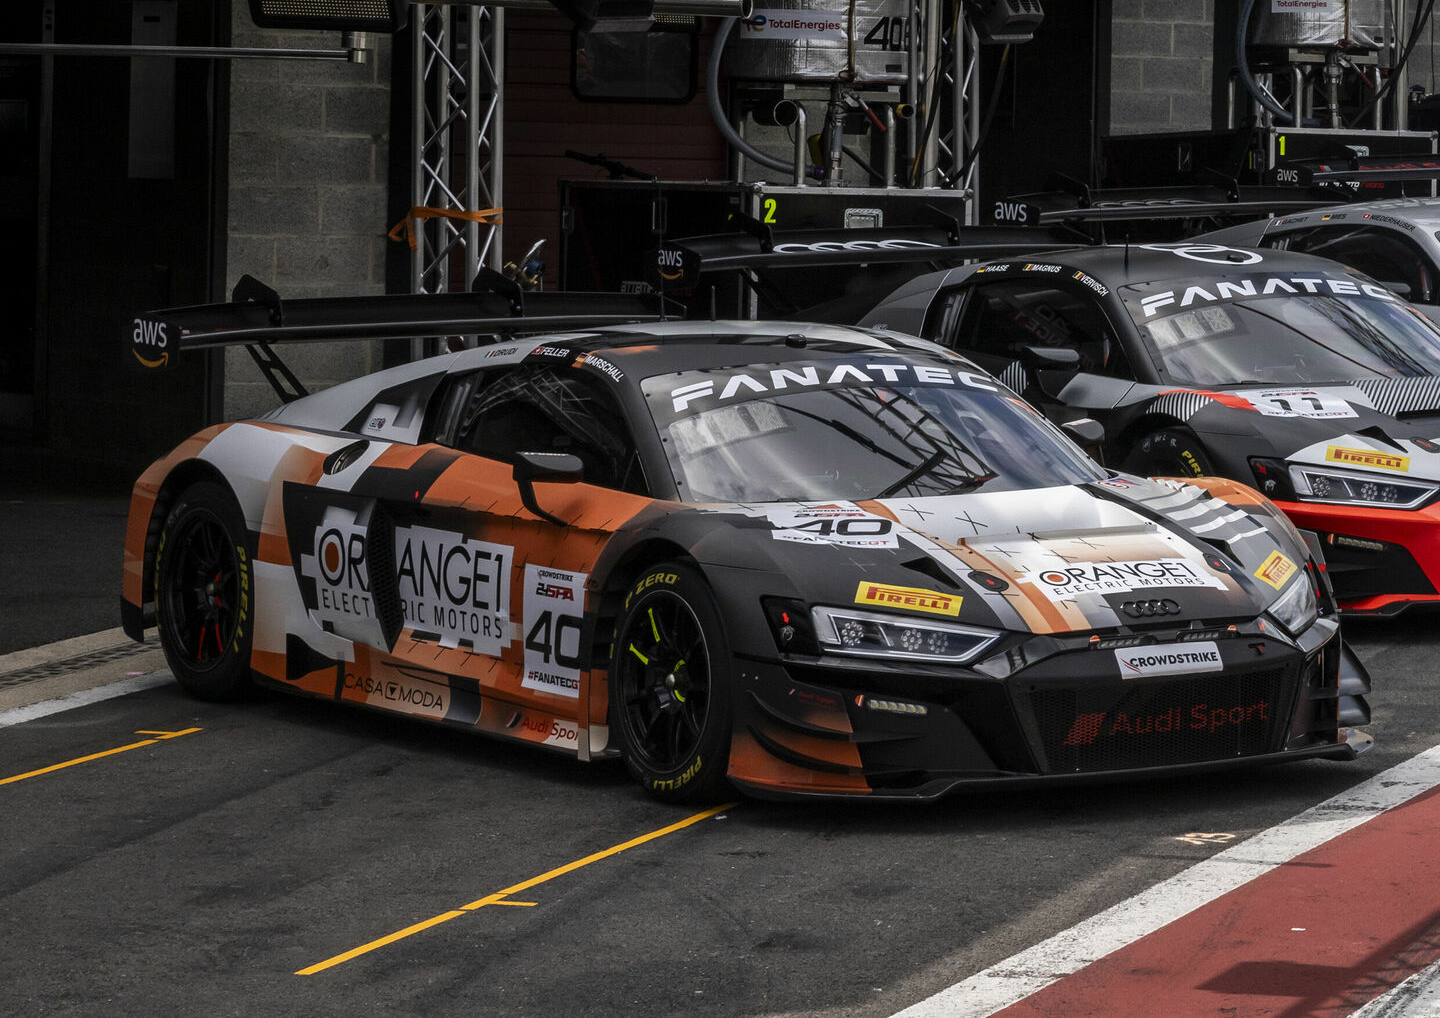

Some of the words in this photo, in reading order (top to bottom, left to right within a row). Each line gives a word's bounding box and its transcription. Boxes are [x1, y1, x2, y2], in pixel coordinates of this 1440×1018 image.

[1277, 0, 1327, 9] TotalEnergies
[769, 19, 840, 31] TotalEnergies
[1277, 168, 1299, 183] aws
[764, 198, 777, 224] 2
[994, 201, 1027, 222] aws
[1370, 213, 1416, 232] NIEDERHAUSER
[658, 249, 683, 267] aws
[985, 264, 1010, 272] HAASE
[1031, 264, 1061, 273] MAGNUS
[1080, 275, 1109, 297] VERVISCH
[1141, 277, 1395, 318] FANATEC
[133, 318, 167, 348] aws
[494, 347, 518, 357] DRUDI
[541, 347, 570, 358] FELLER
[584, 355, 625, 383] MARSCHALL
[671, 364, 998, 413] FANATEC
[1270, 397, 1324, 411] 11
[1334, 449, 1403, 470] PIRELLI
[788, 519, 892, 537] 40
[539, 569, 573, 582] CROWDSTRIKE
[1039, 561, 1198, 589] ORANGE1
[1262, 555, 1292, 584] PIRELLI
[635, 572, 678, 595] ZERO
[1053, 580, 1131, 596] ELECTRIC
[1139, 576, 1206, 590] MOTORS
[866, 584, 951, 612] PIRELLI
[434, 606, 503, 639] MOTORS
[525, 610, 584, 670] 40
[1127, 651, 1220, 669] CROWDSTRIKE
[344, 673, 383, 693] CASA
[399, 689, 443, 711] MODA
[528, 670, 580, 690] #FANATECG
[522, 716, 548, 733] Audi
[551, 721, 579, 743] Spor
[1108, 708, 1181, 736] Audi
[1190, 699, 1270, 733] Sport
[653, 756, 703, 790] PIRELLI
